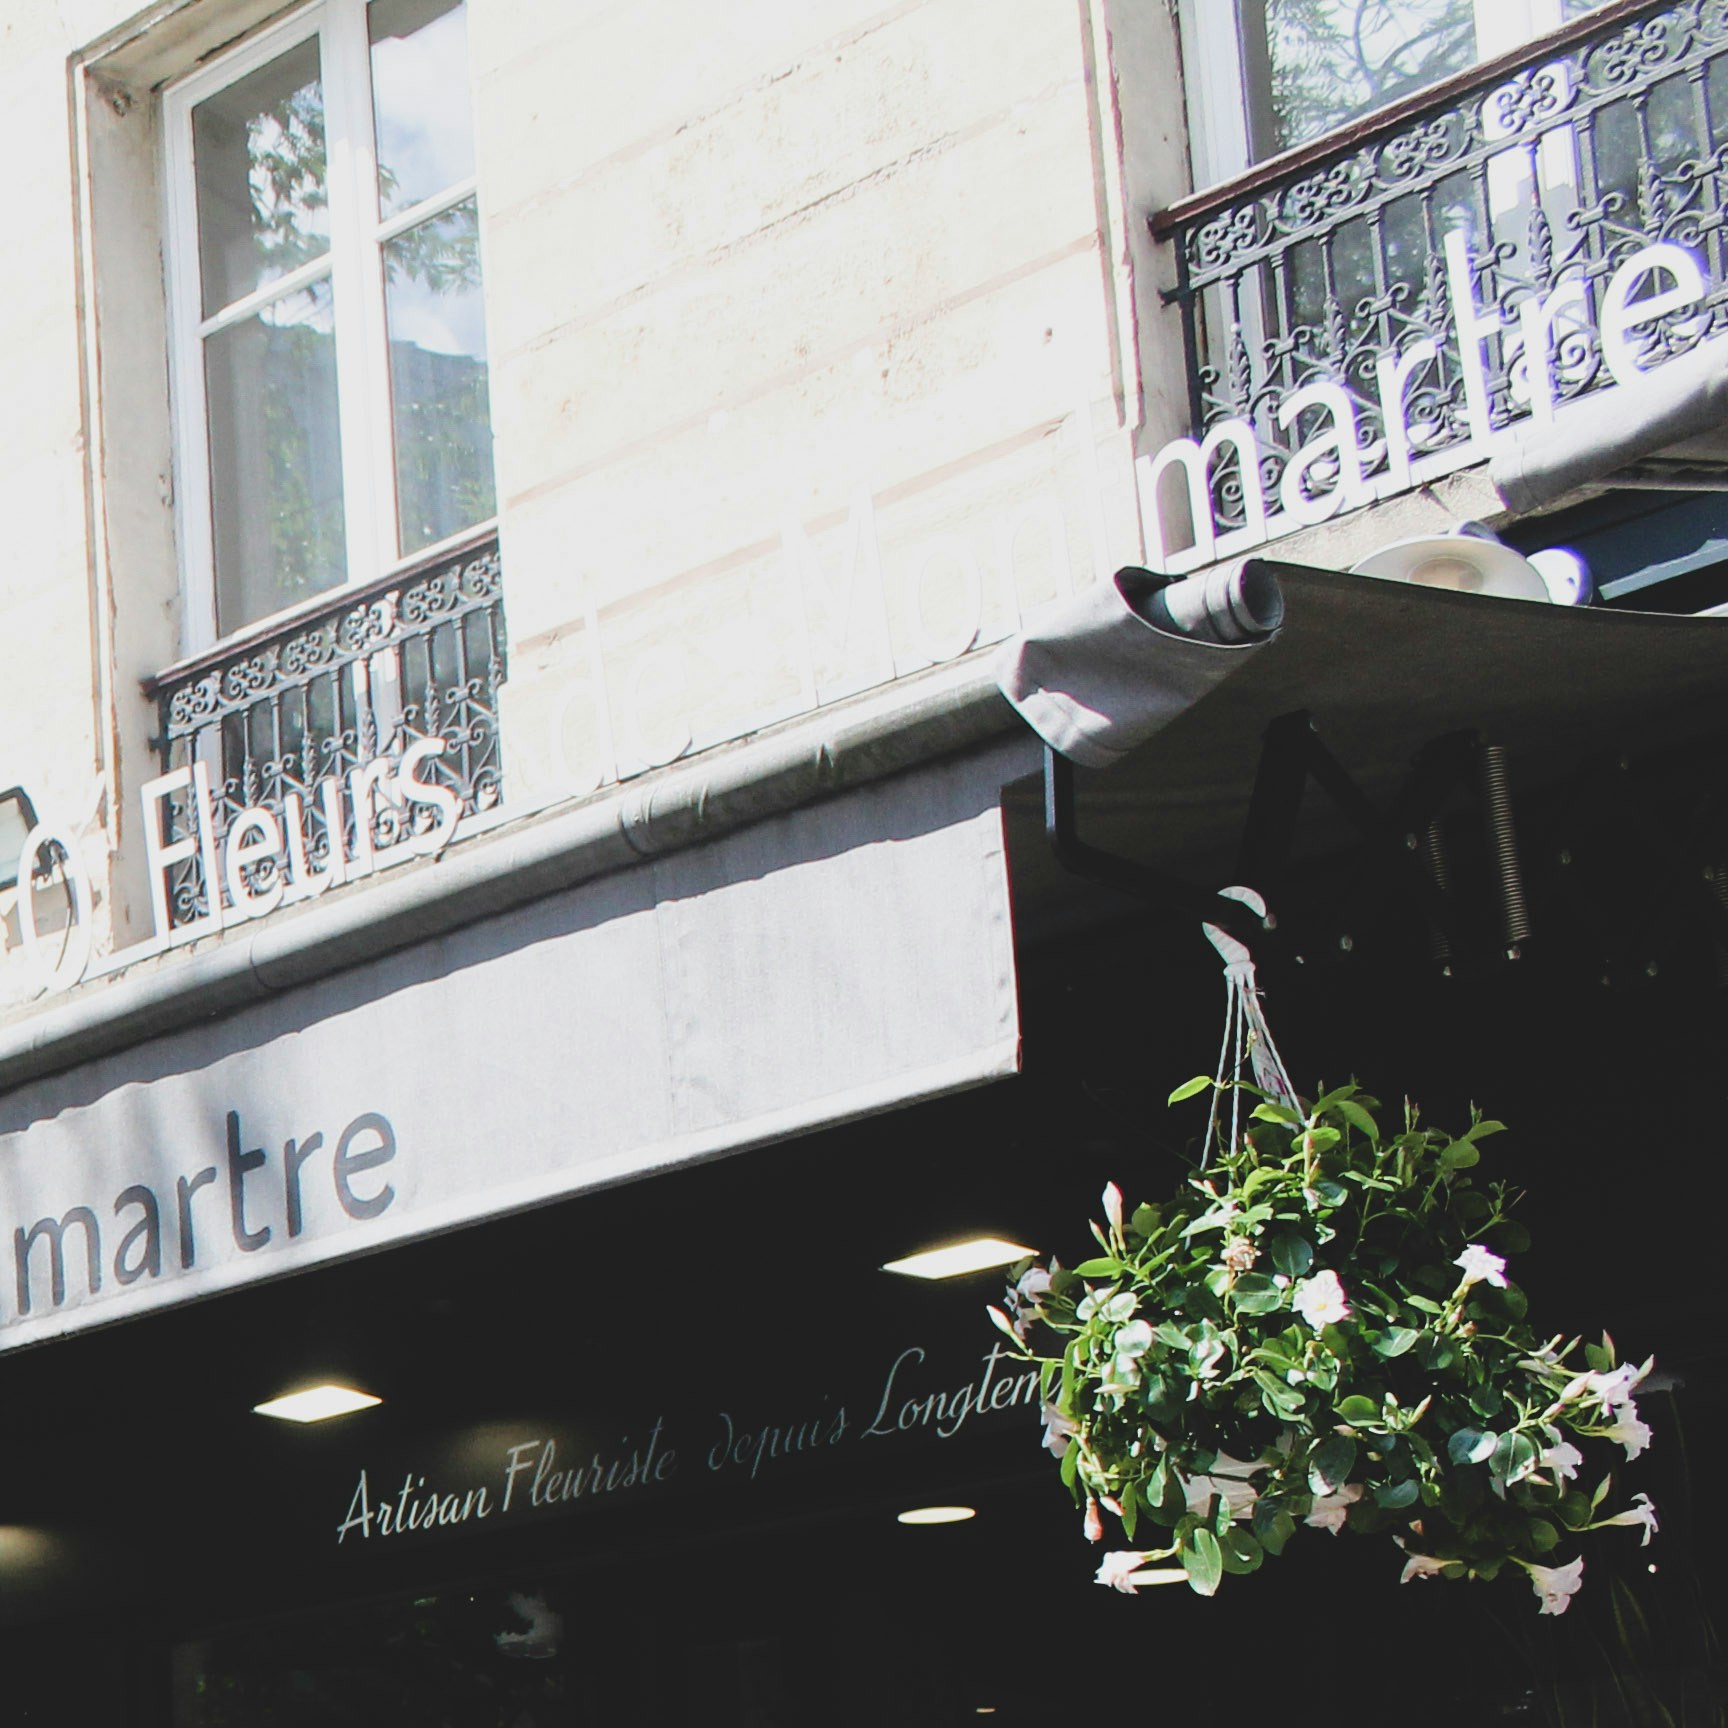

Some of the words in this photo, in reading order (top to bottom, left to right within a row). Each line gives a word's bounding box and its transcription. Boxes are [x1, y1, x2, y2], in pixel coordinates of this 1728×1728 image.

[336, 1469, 493, 1544] Artisan
[502, 1415, 679, 1514] Fleuriste
[706, 1395, 850, 1479] depuis
[860, 1341, 1064, 1441] Longtem
